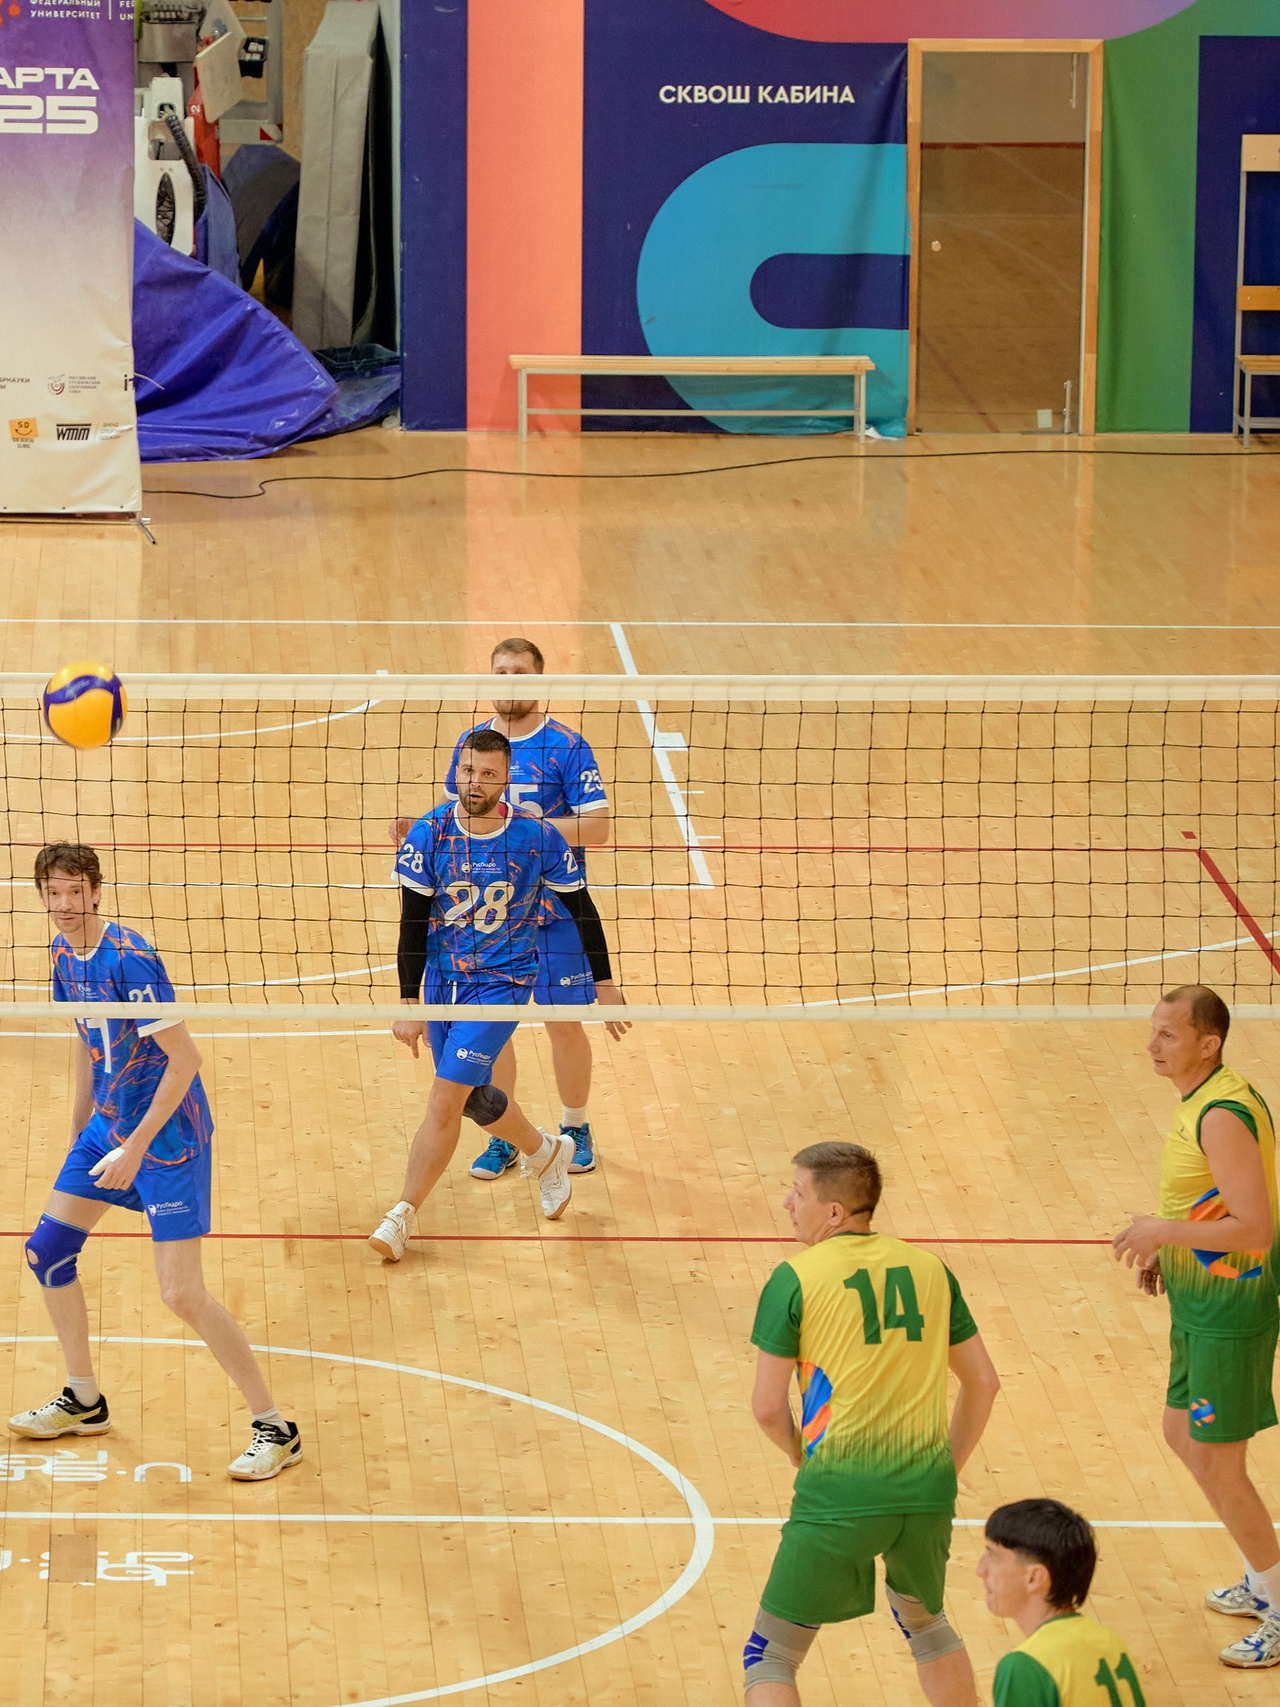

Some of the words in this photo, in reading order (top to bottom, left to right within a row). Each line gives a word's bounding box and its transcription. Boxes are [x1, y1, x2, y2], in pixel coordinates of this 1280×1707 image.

[30, 10, 101, 19] УНИВЕРСИТЕТ
[659, 85, 750, 104] СКВОШ
[758, 85, 855, 104] КАБИНА
[507, 783, 544, 817] 5
[398, 843, 424, 874] 28
[444, 880, 515, 934] 28
[843, 1266, 925, 1345] 14
[1094, 1652, 1148, 1707] 11
